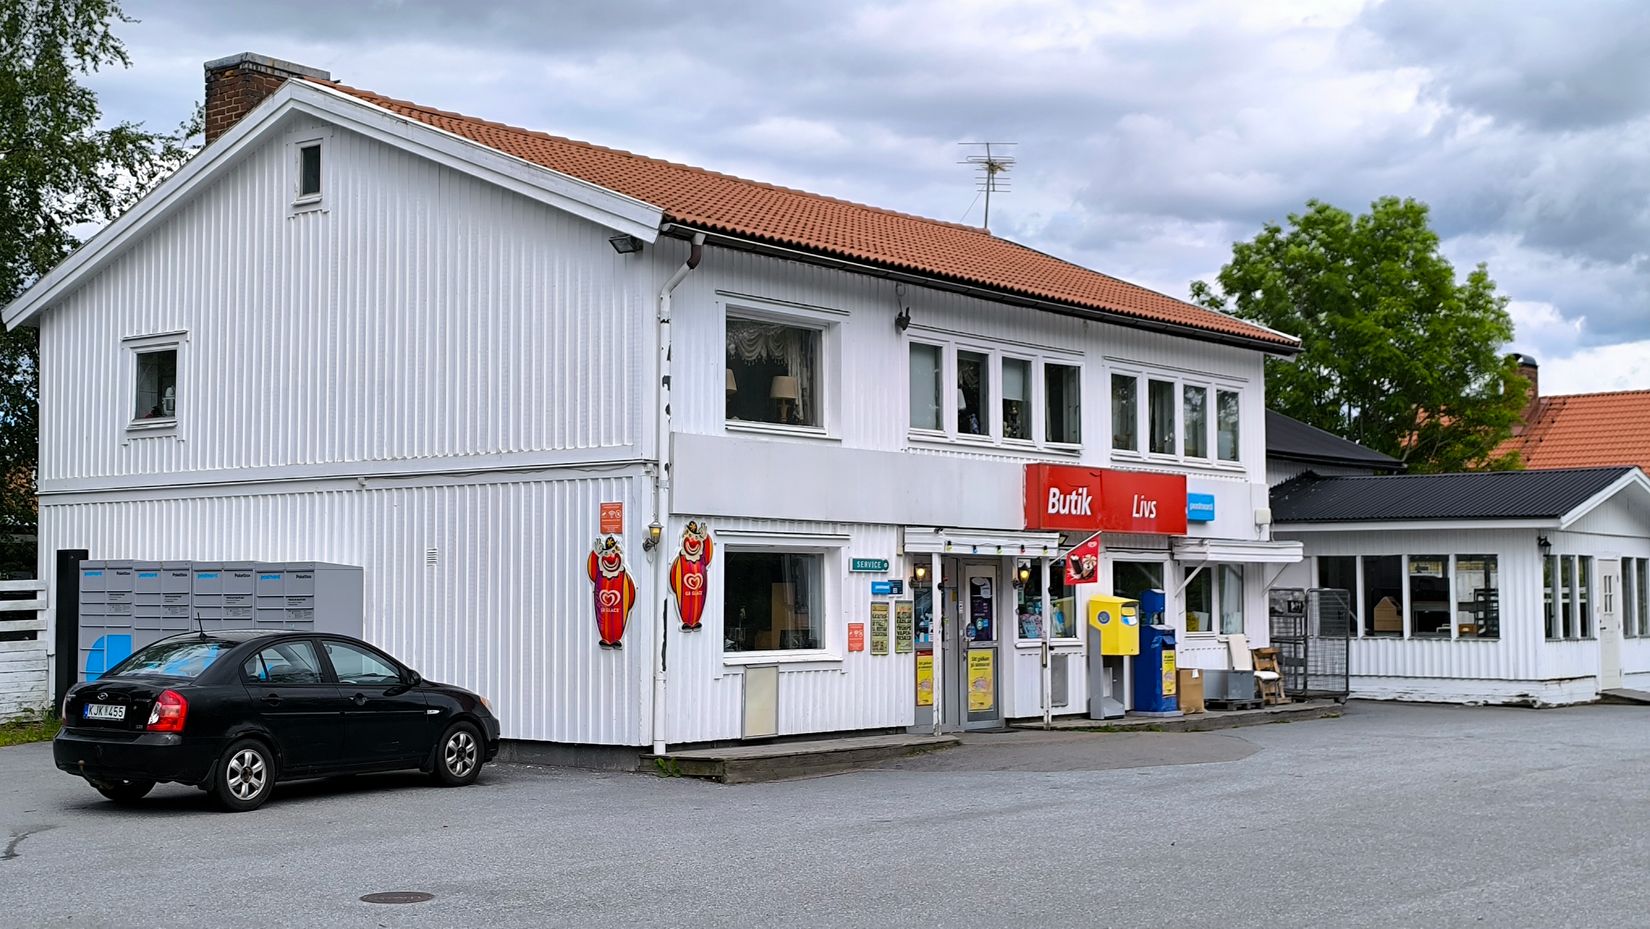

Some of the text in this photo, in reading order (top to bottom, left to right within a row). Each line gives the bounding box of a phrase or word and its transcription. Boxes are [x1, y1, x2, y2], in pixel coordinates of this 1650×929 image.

[1047, 486, 1157, 519] Butik Livs
[856, 560, 882, 568] SERVICE
[89, 704, 124, 717] KJK 455
